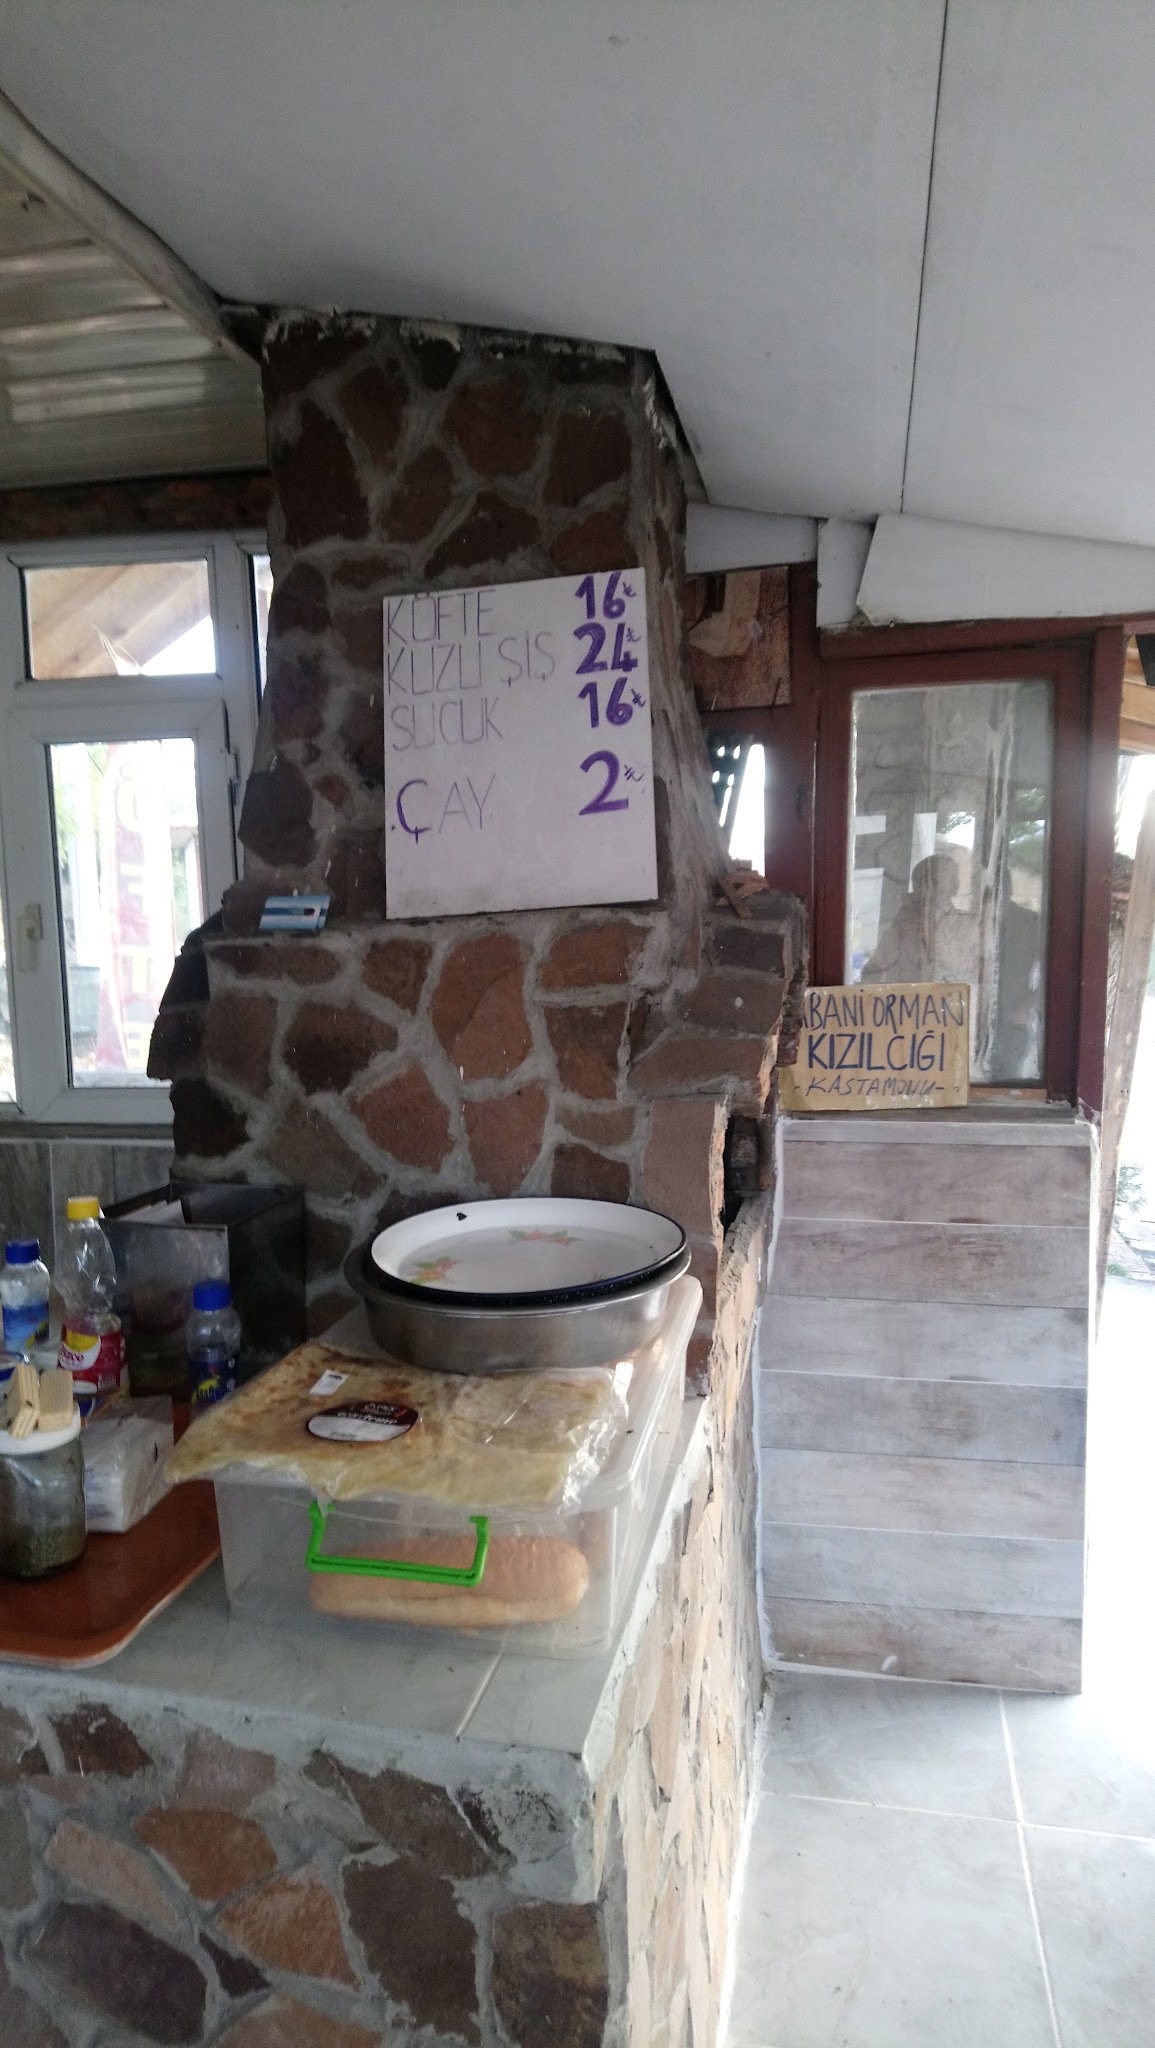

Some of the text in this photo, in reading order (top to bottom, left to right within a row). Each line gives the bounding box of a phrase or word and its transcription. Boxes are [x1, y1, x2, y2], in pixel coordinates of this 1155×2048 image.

[387, 588, 497, 646] KÖFTE
[387, 641, 482, 696] KUZU
[391, 697, 503, 751] SUCUK
[397, 774, 496, 844] ÇAY
[873, 991, 964, 1034] ORMAN
[808, 1030, 945, 1072] KIZILCIĞI
